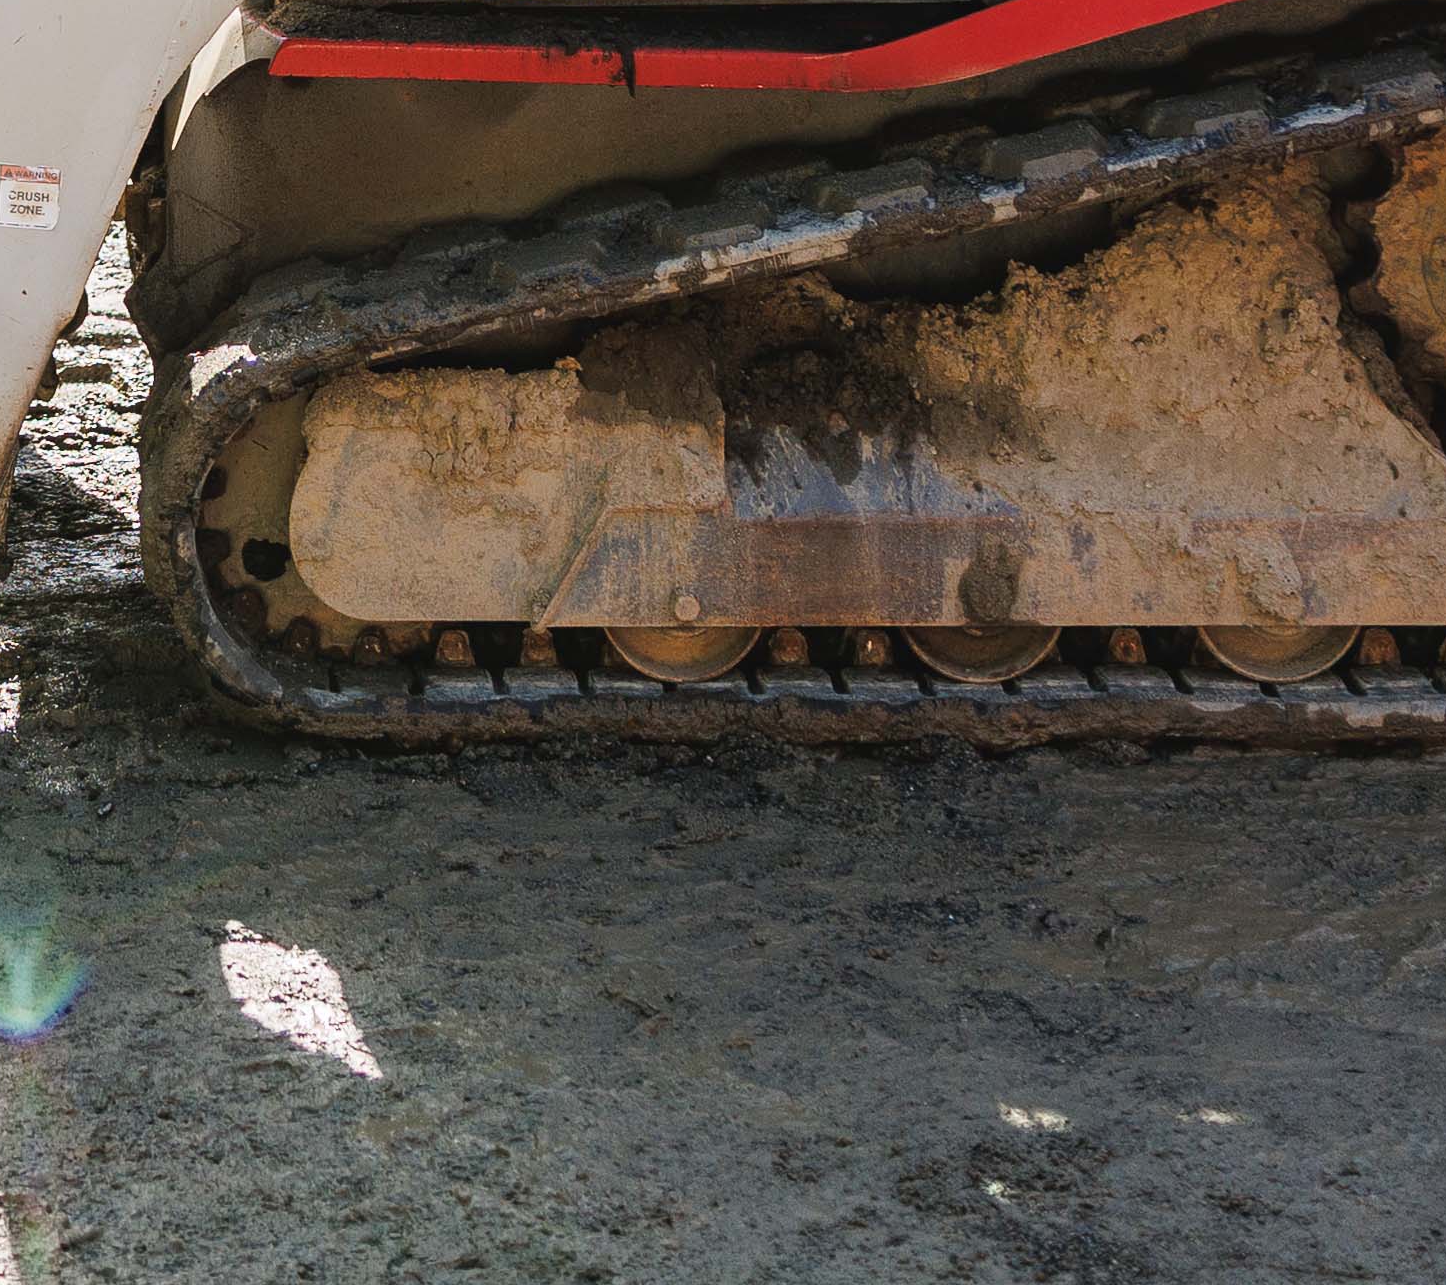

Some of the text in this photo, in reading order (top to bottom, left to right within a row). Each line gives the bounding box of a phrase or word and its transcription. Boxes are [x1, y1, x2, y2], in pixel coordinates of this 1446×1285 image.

[15, 170, 58, 180] WARNING
[9, 190, 49, 202] CRUSH
[10, 204, 45, 216] ZONE.
